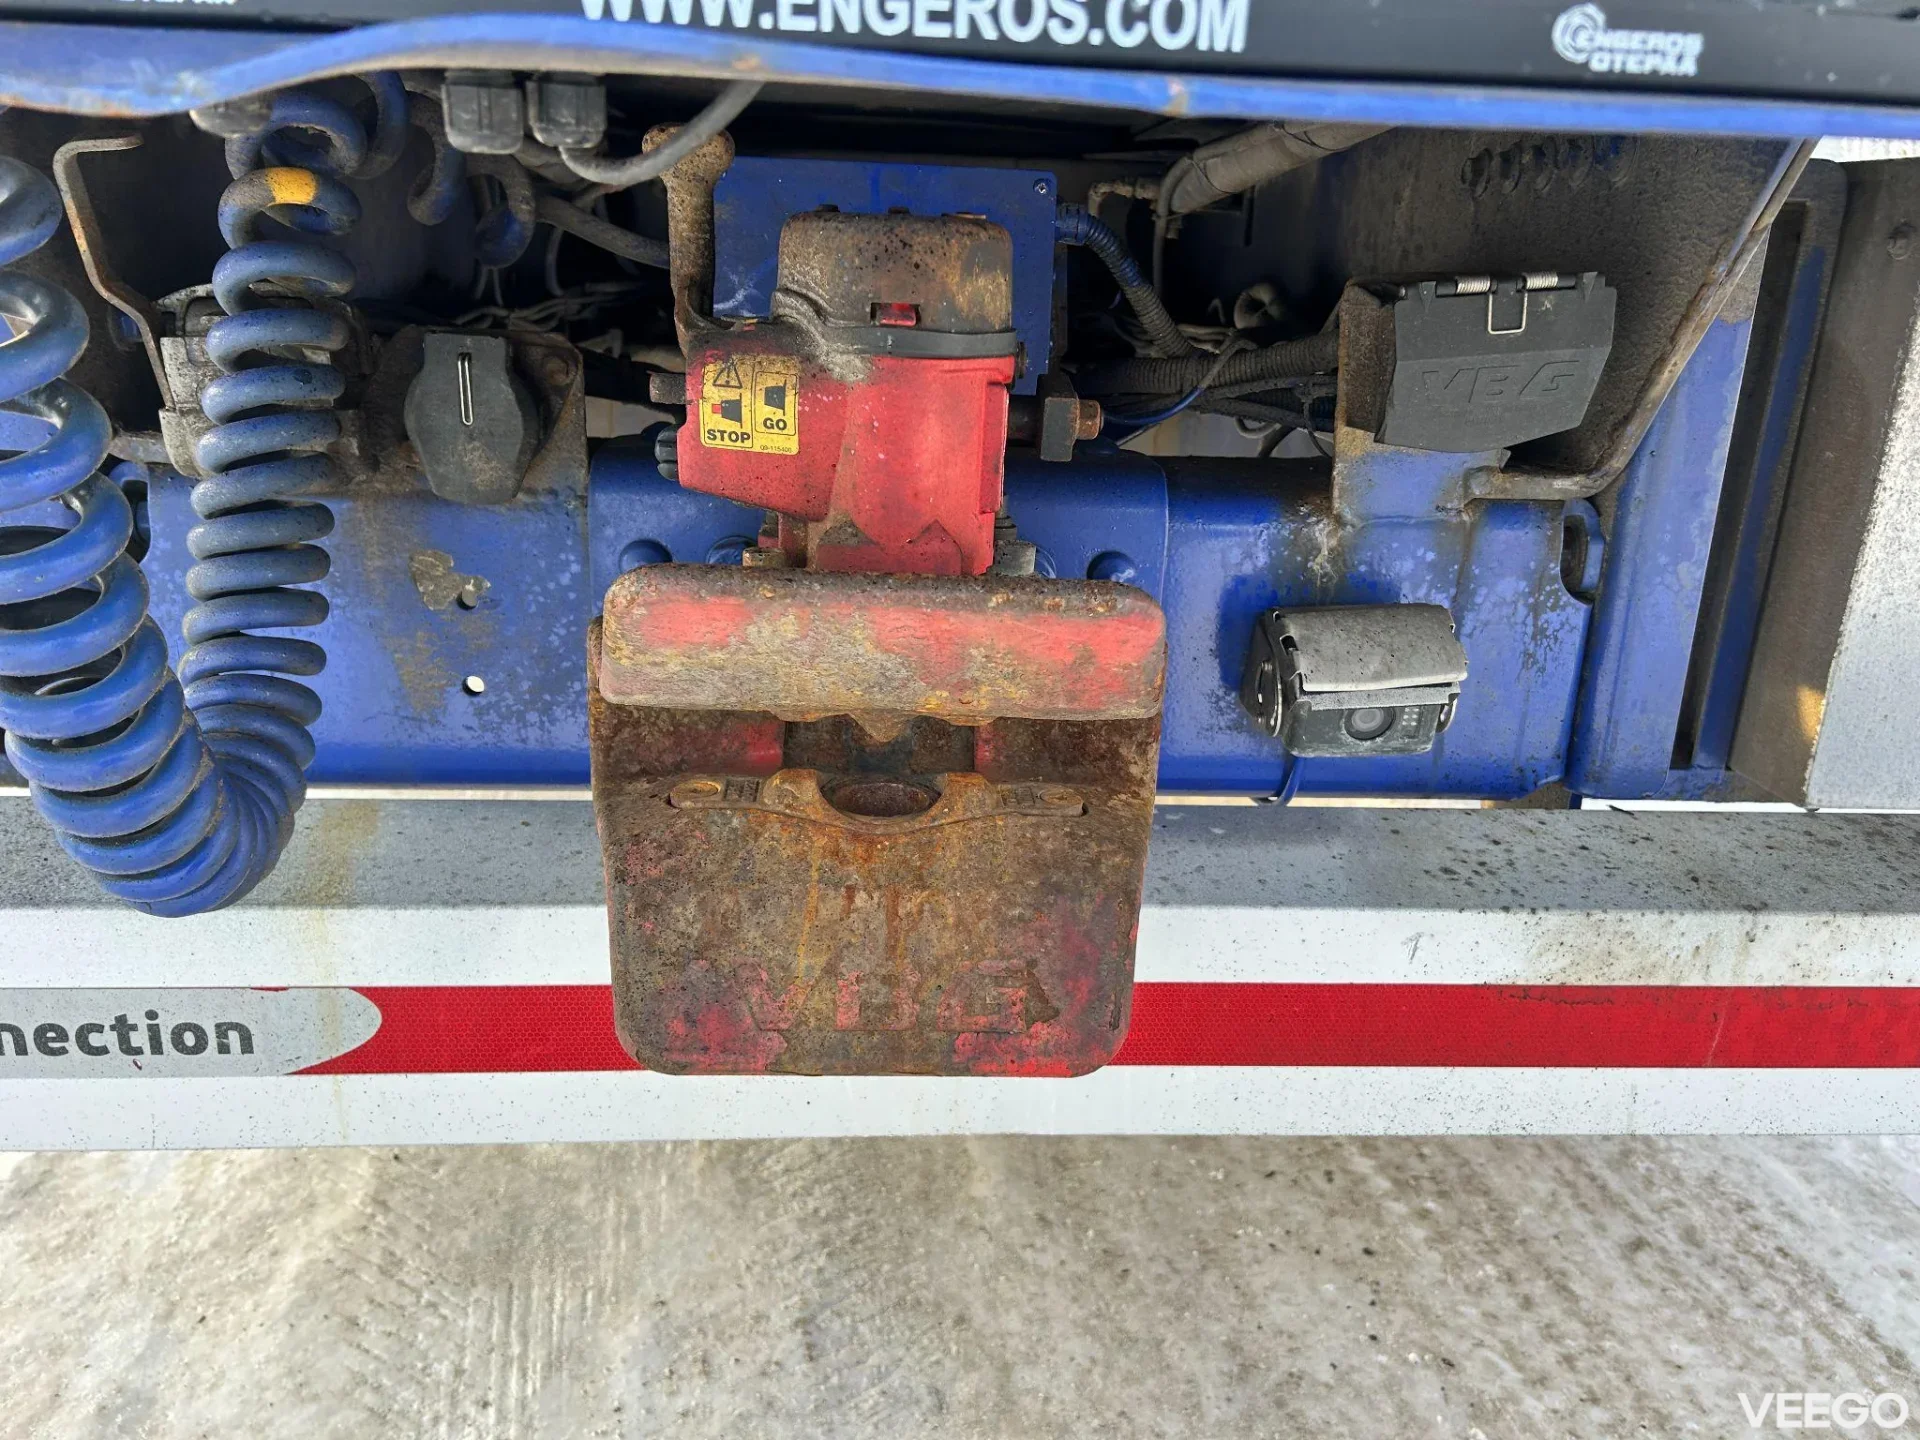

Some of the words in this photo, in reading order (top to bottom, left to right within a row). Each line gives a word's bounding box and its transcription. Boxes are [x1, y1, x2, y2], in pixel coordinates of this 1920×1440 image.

[1421, 359, 1580, 407] VBG
[706, 428, 751, 444] STOP
[762, 416, 788, 431] GO
[0, 1009, 254, 1057] nection
